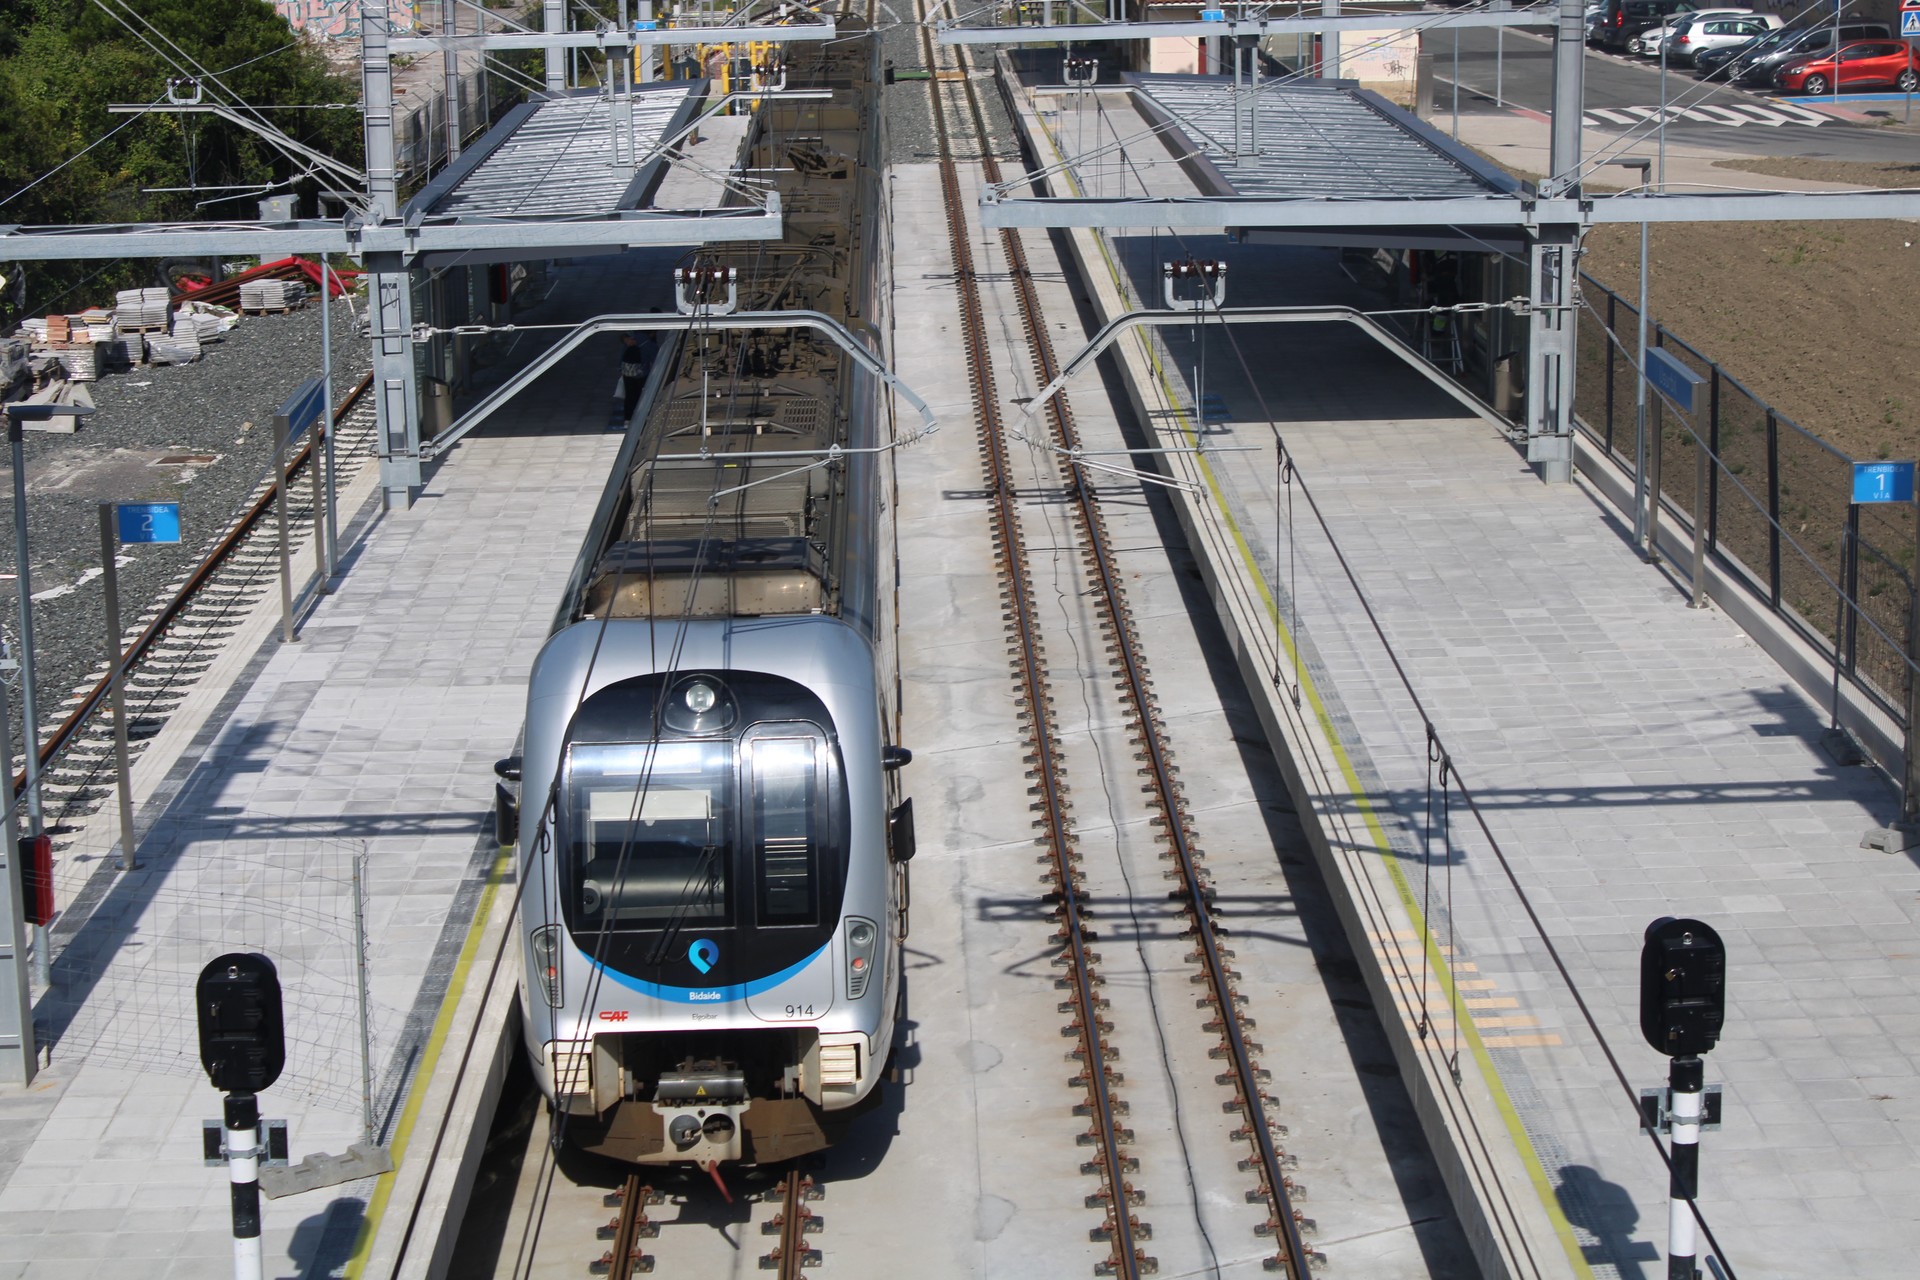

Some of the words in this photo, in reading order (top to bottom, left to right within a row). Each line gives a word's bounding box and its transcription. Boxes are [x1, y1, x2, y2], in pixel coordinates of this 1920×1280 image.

[1863, 465, 1904, 473] TRENBIDEA
[1875, 473, 1885, 491] 1
[141, 514, 154, 531] 2
[689, 991, 721, 1000] Bidaide
[599, 1010, 629, 1022] CAF
[785, 1004, 814, 1018] 914
